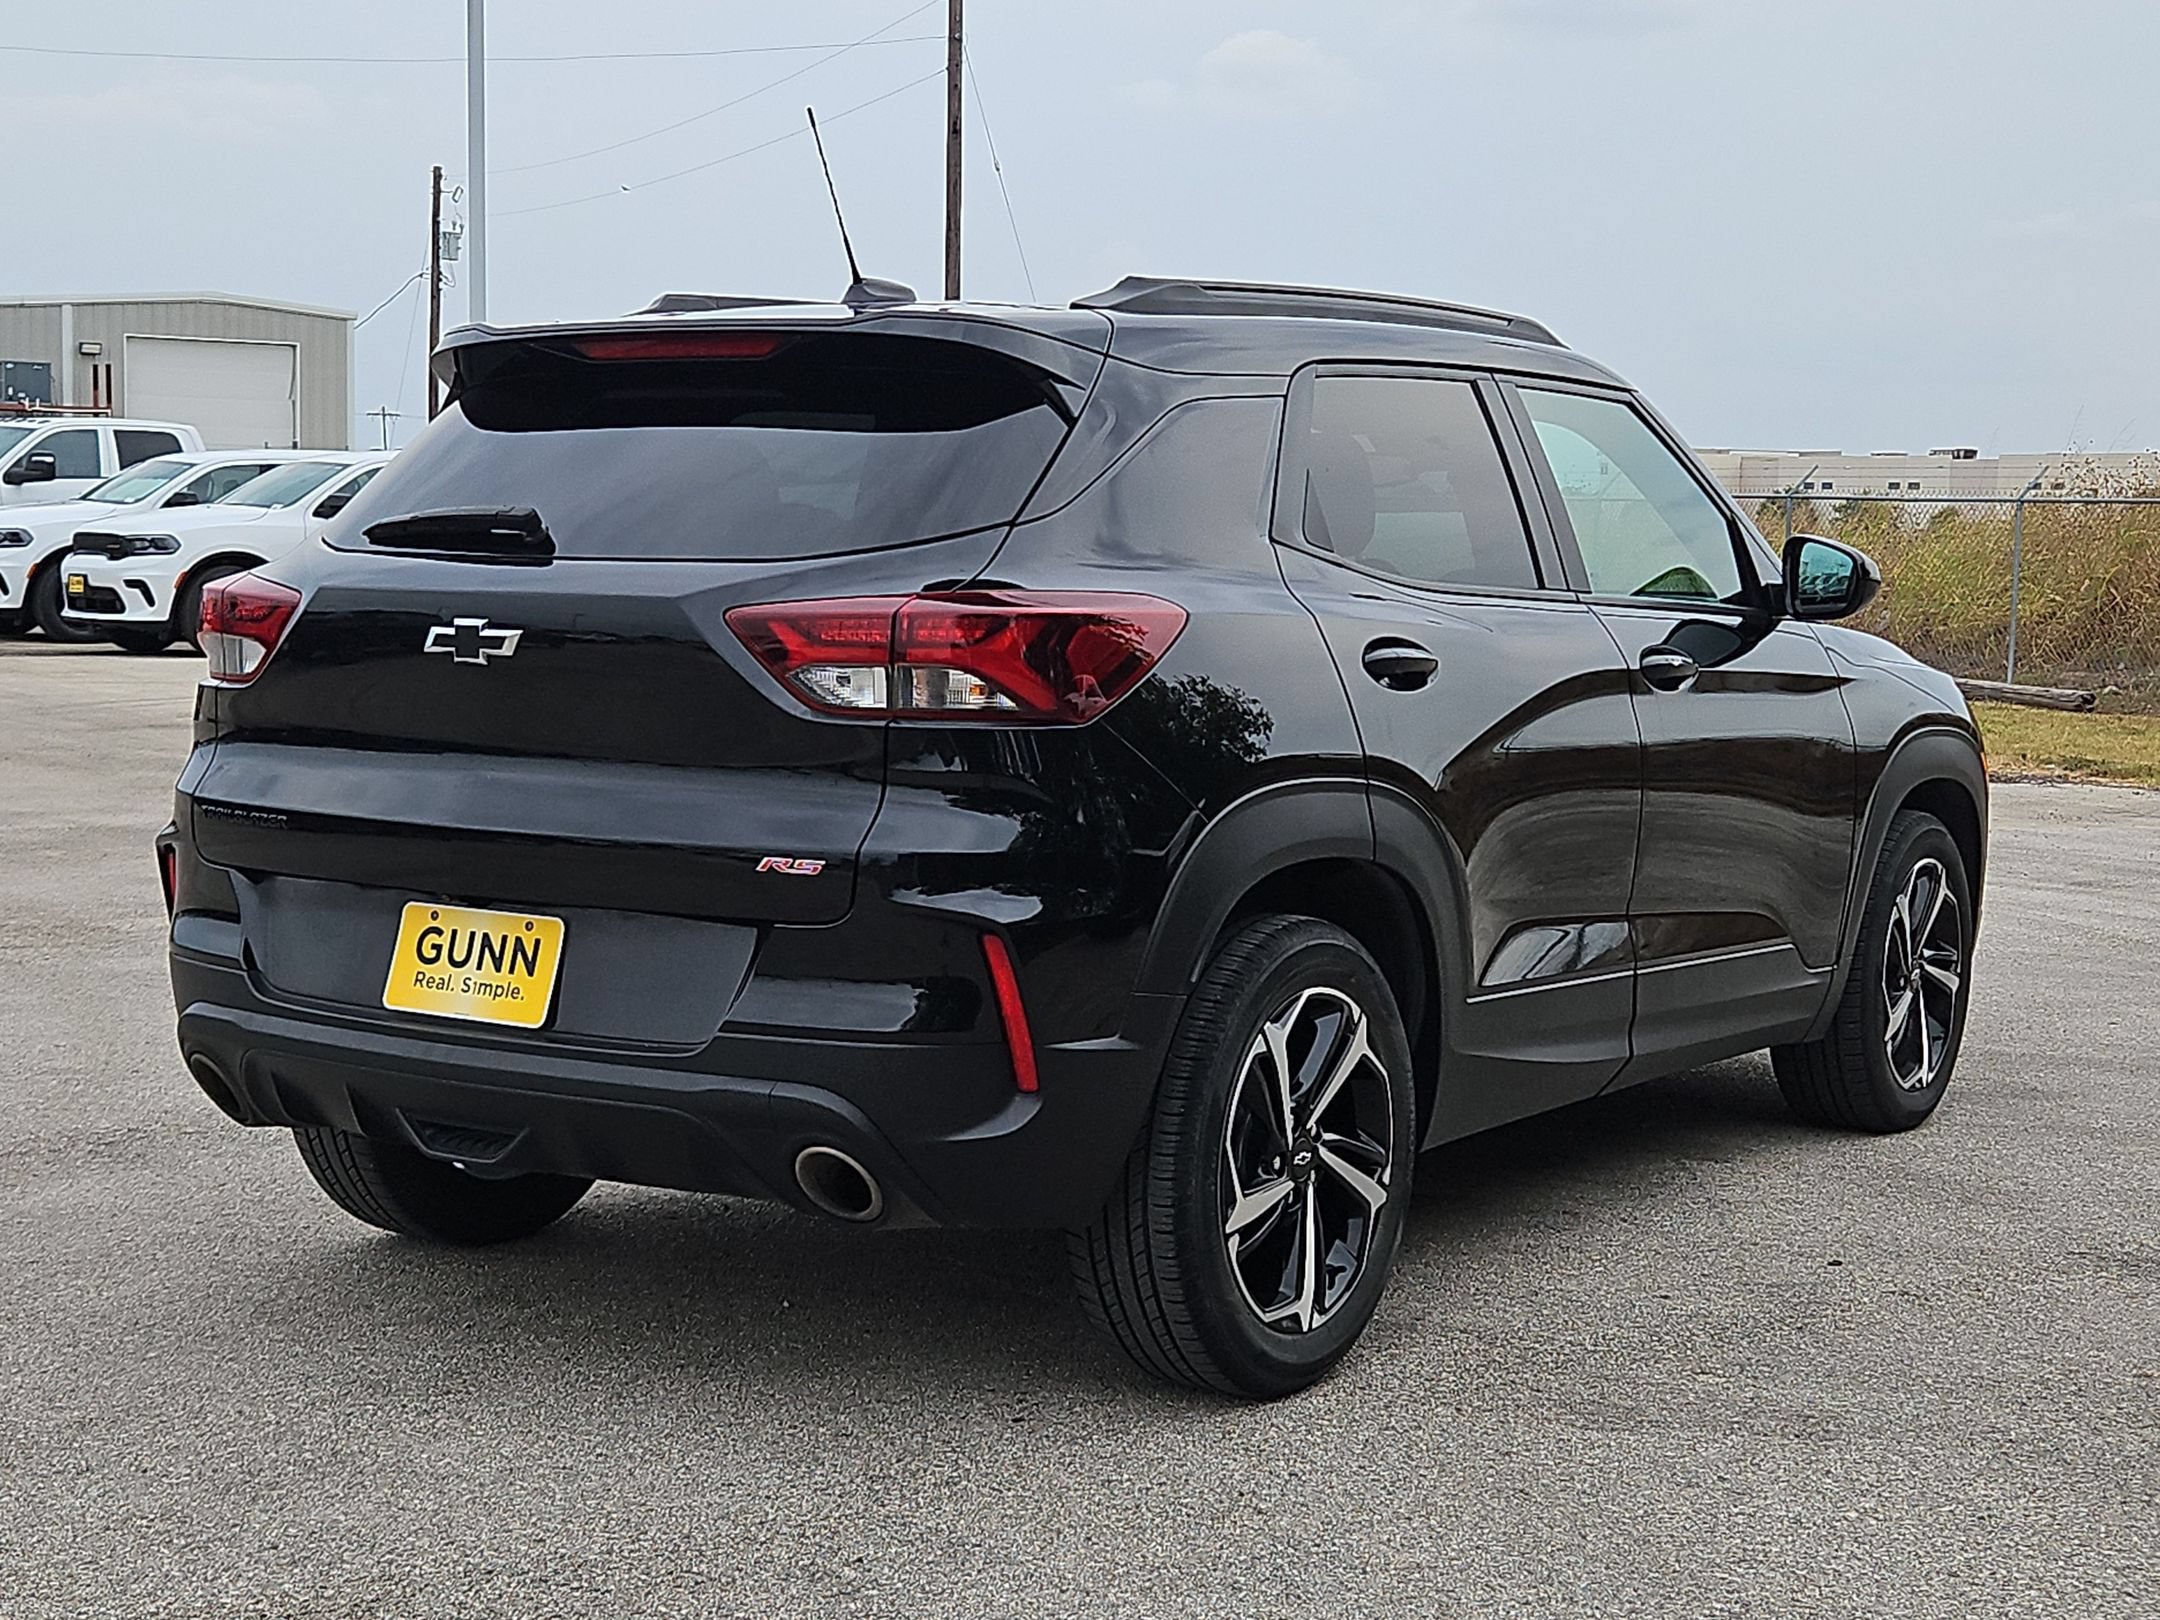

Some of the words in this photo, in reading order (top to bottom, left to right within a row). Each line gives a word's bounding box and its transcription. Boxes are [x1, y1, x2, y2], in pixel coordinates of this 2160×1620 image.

[755, 856, 826, 875] RS
[415, 925, 542, 978] GUNN
[413, 970, 455, 992] Real.
[460, 976, 525, 1001] Simple.
